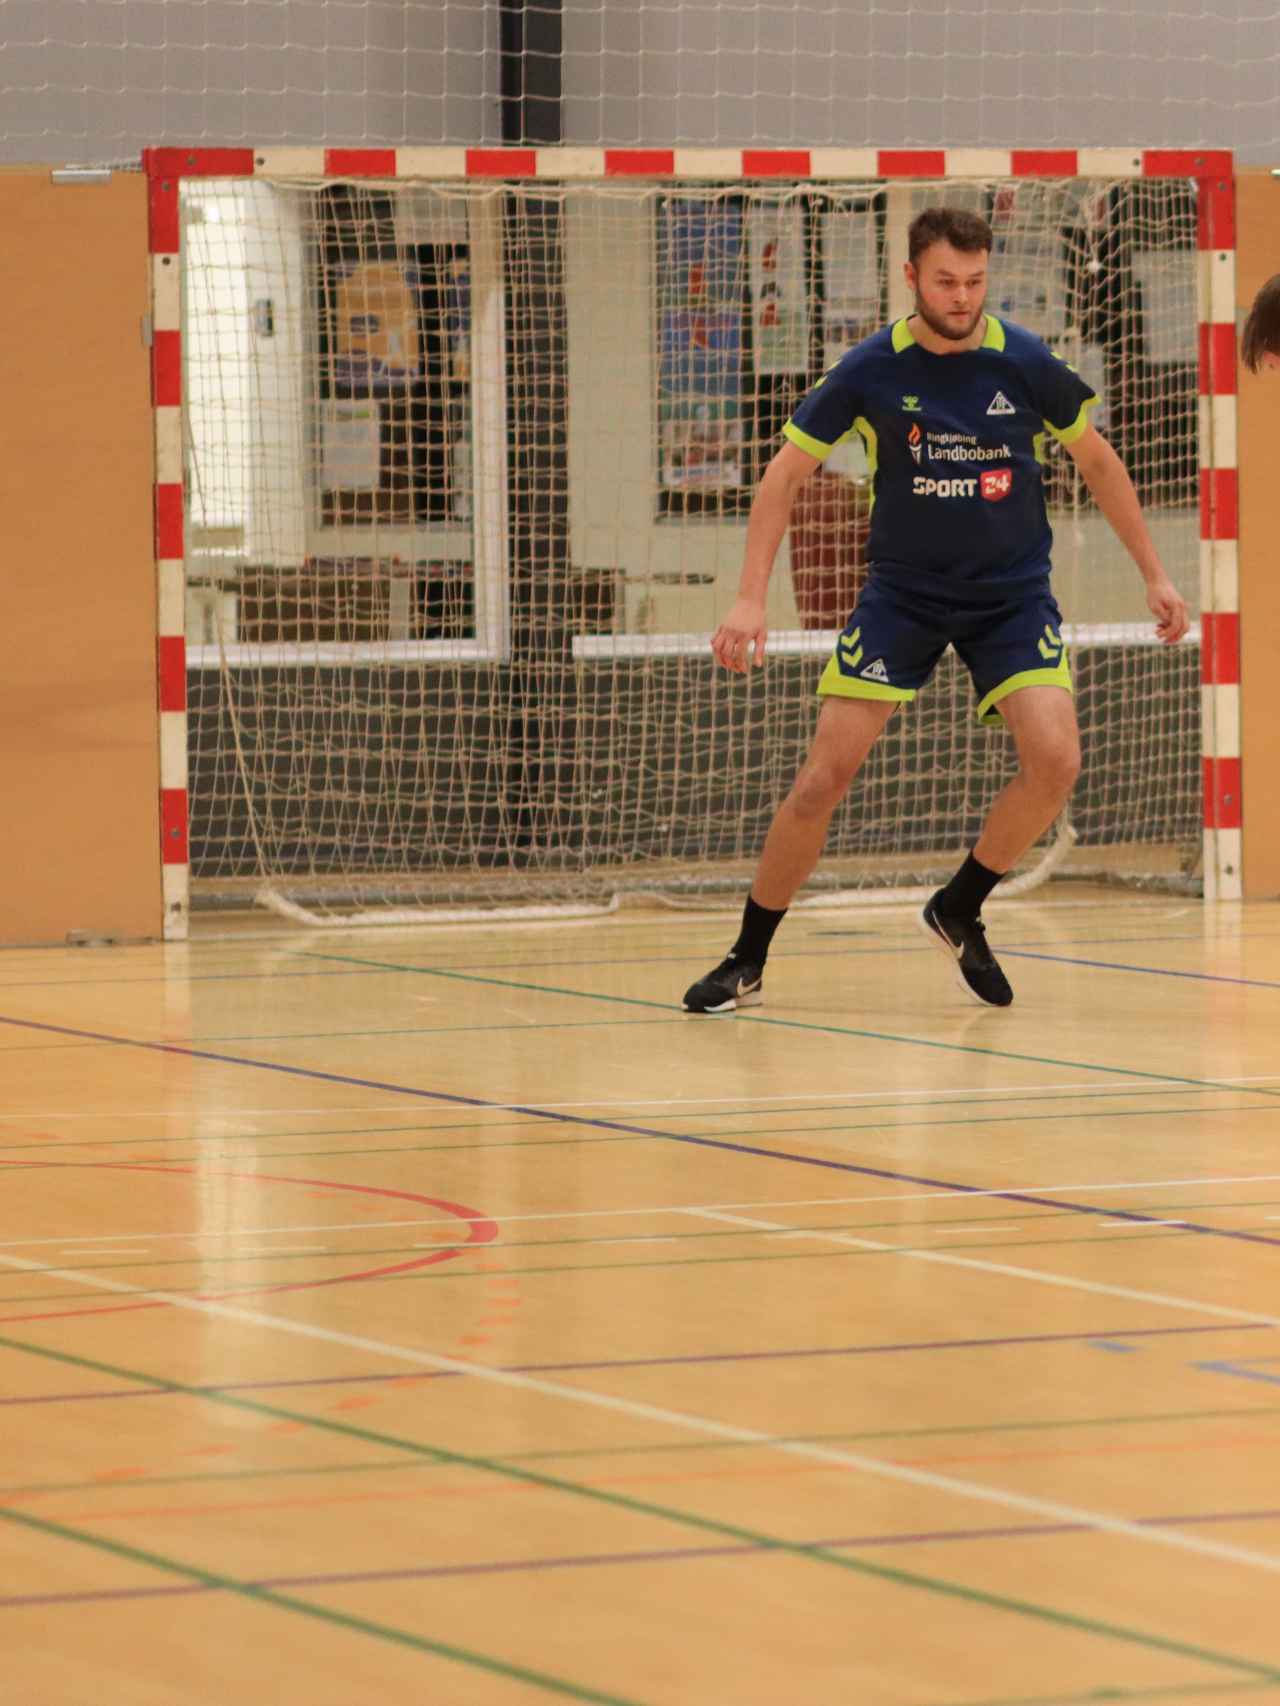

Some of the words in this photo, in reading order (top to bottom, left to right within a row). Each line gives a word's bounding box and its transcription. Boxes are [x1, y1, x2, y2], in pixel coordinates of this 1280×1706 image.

[927, 443, 1012, 462] Landbobank
[913, 475, 978, 498] SPORT
[984, 474, 1009, 495] 24
